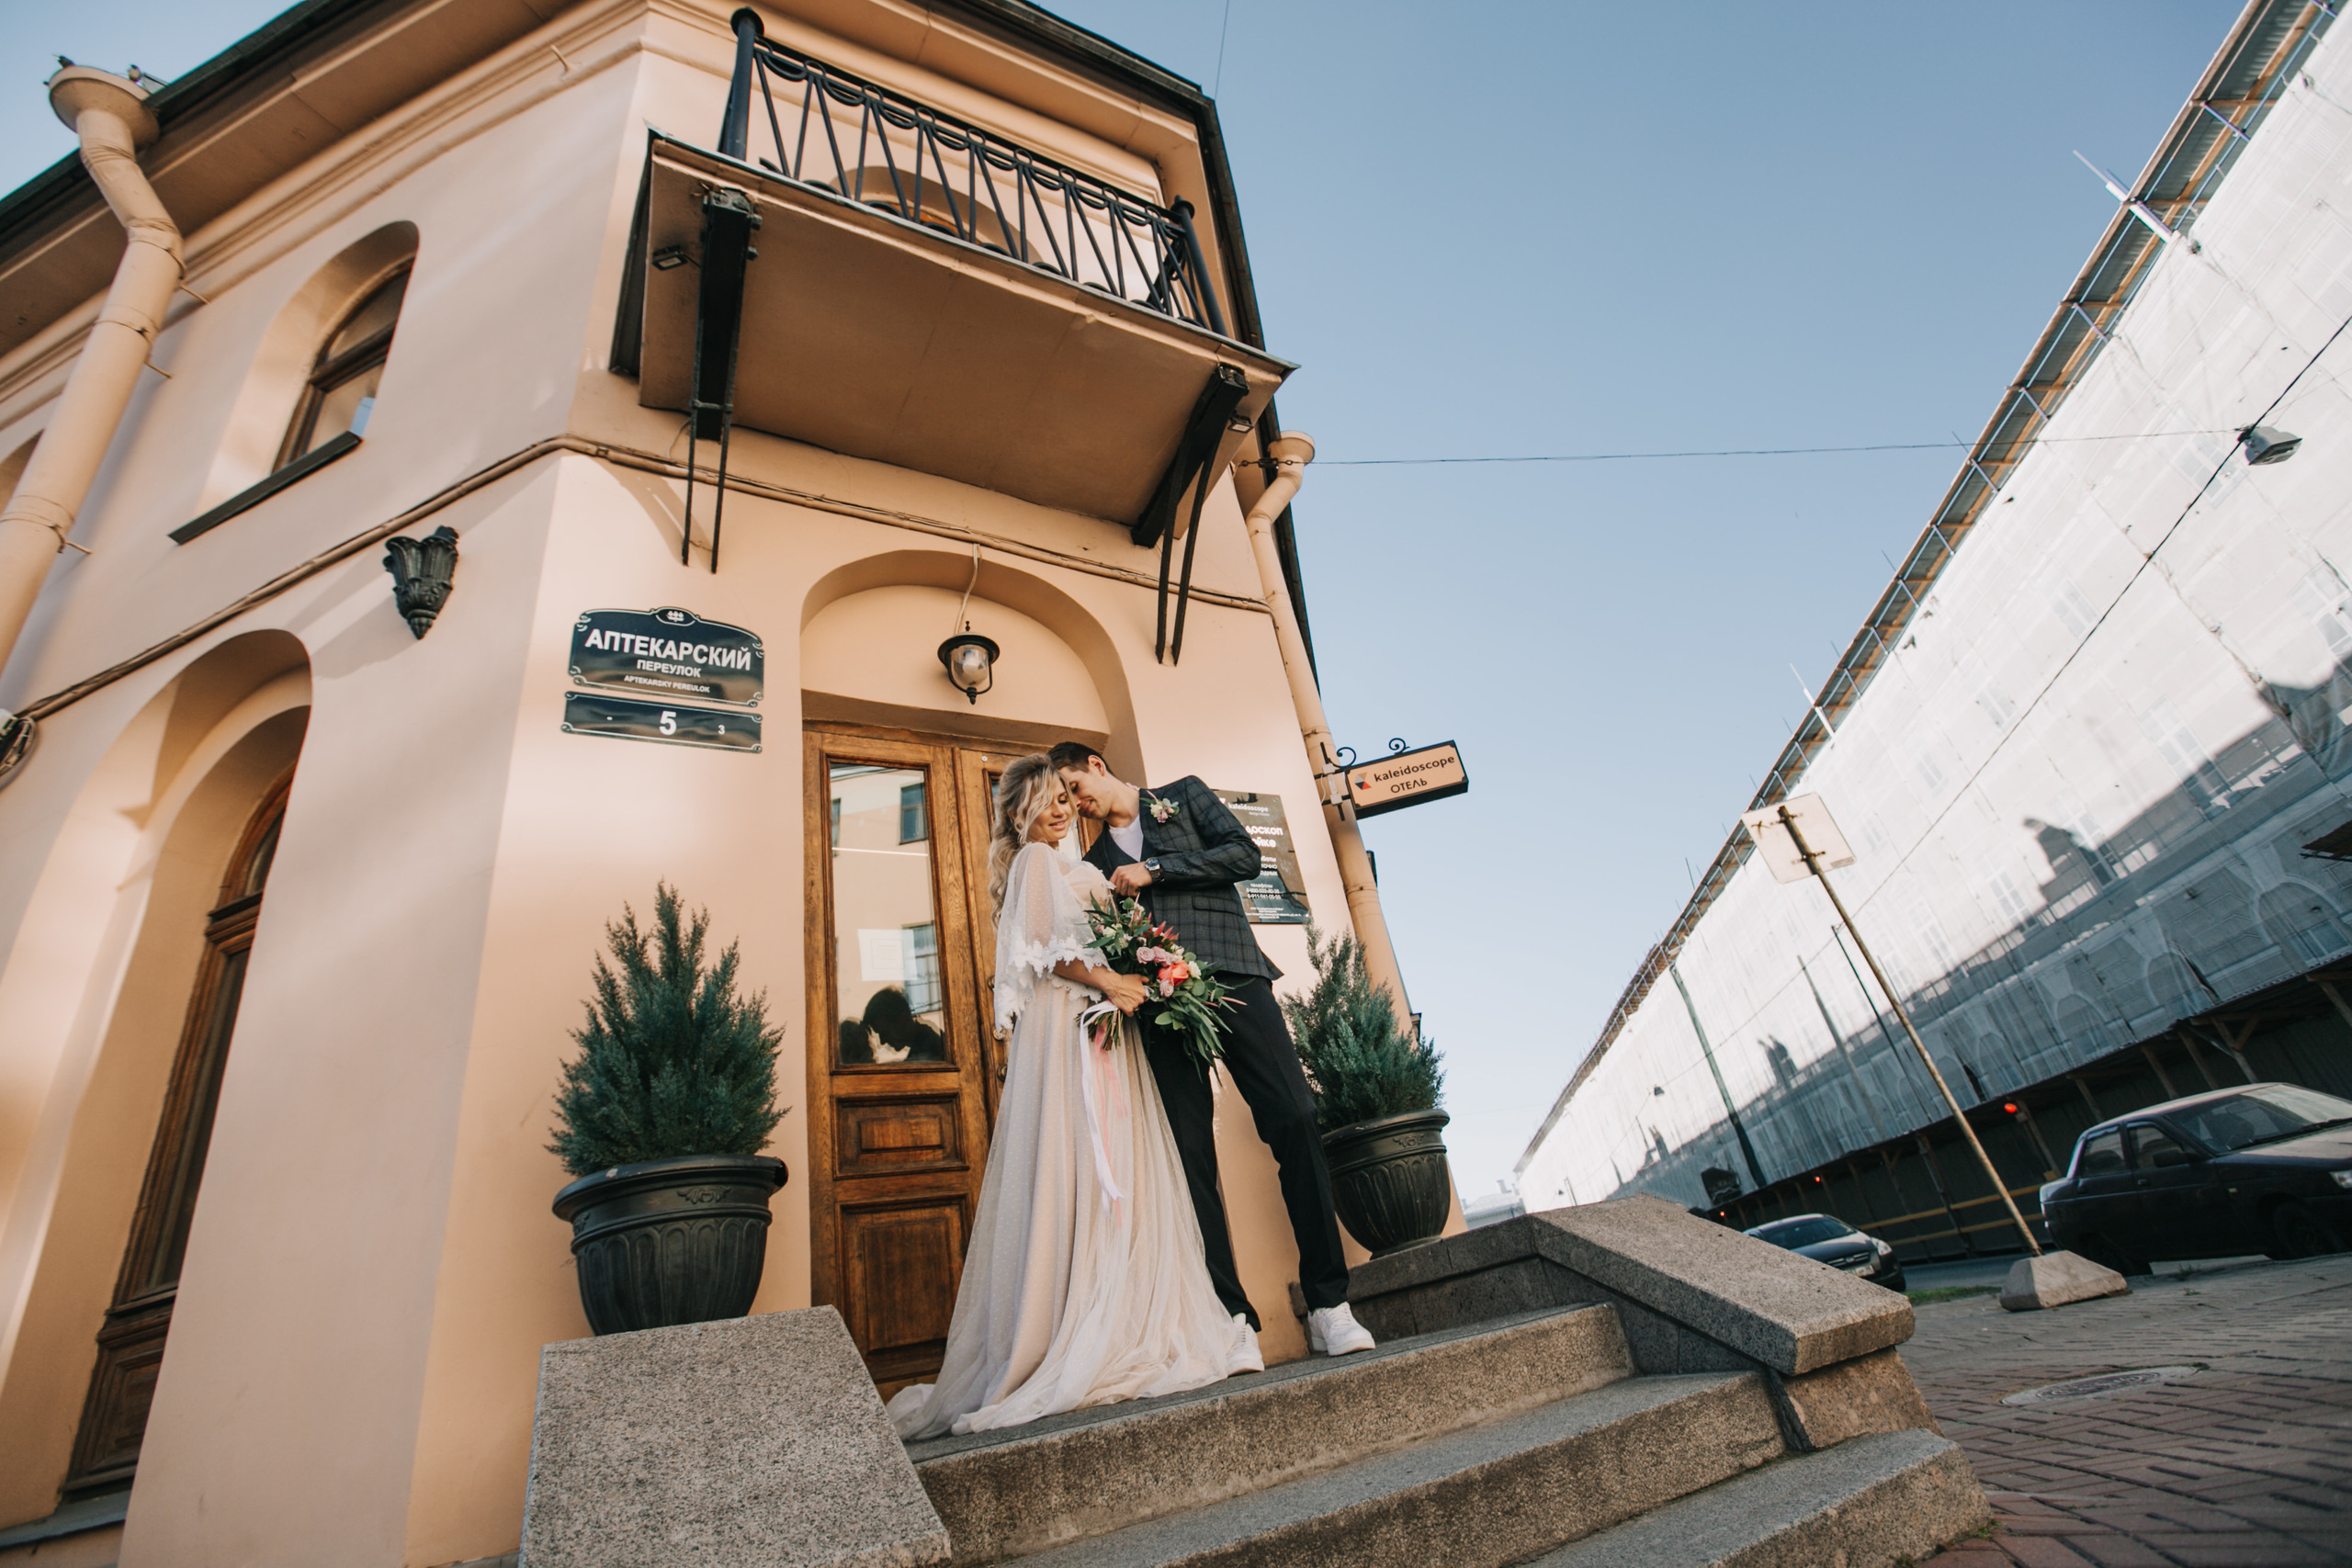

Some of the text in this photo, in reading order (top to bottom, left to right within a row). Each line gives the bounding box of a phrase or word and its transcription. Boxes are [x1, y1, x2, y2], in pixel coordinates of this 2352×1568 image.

[584, 628, 752, 671] АПТЕКАРСКИЙ
[637, 660, 701, 678] ПЕРЕУЛОК
[624, 675, 710, 694] APTEKARSKY PEREULOK
[659, 710, 677, 735] 5
[718, 724, 726, 735] 3
[1374, 756, 1455, 782] kaleidoscope
[1390, 778, 1428, 794] ОТЕЛЬ
[1227, 802, 1269, 813] kaleidoscope
[1245, 825, 1283, 836] доскоп
